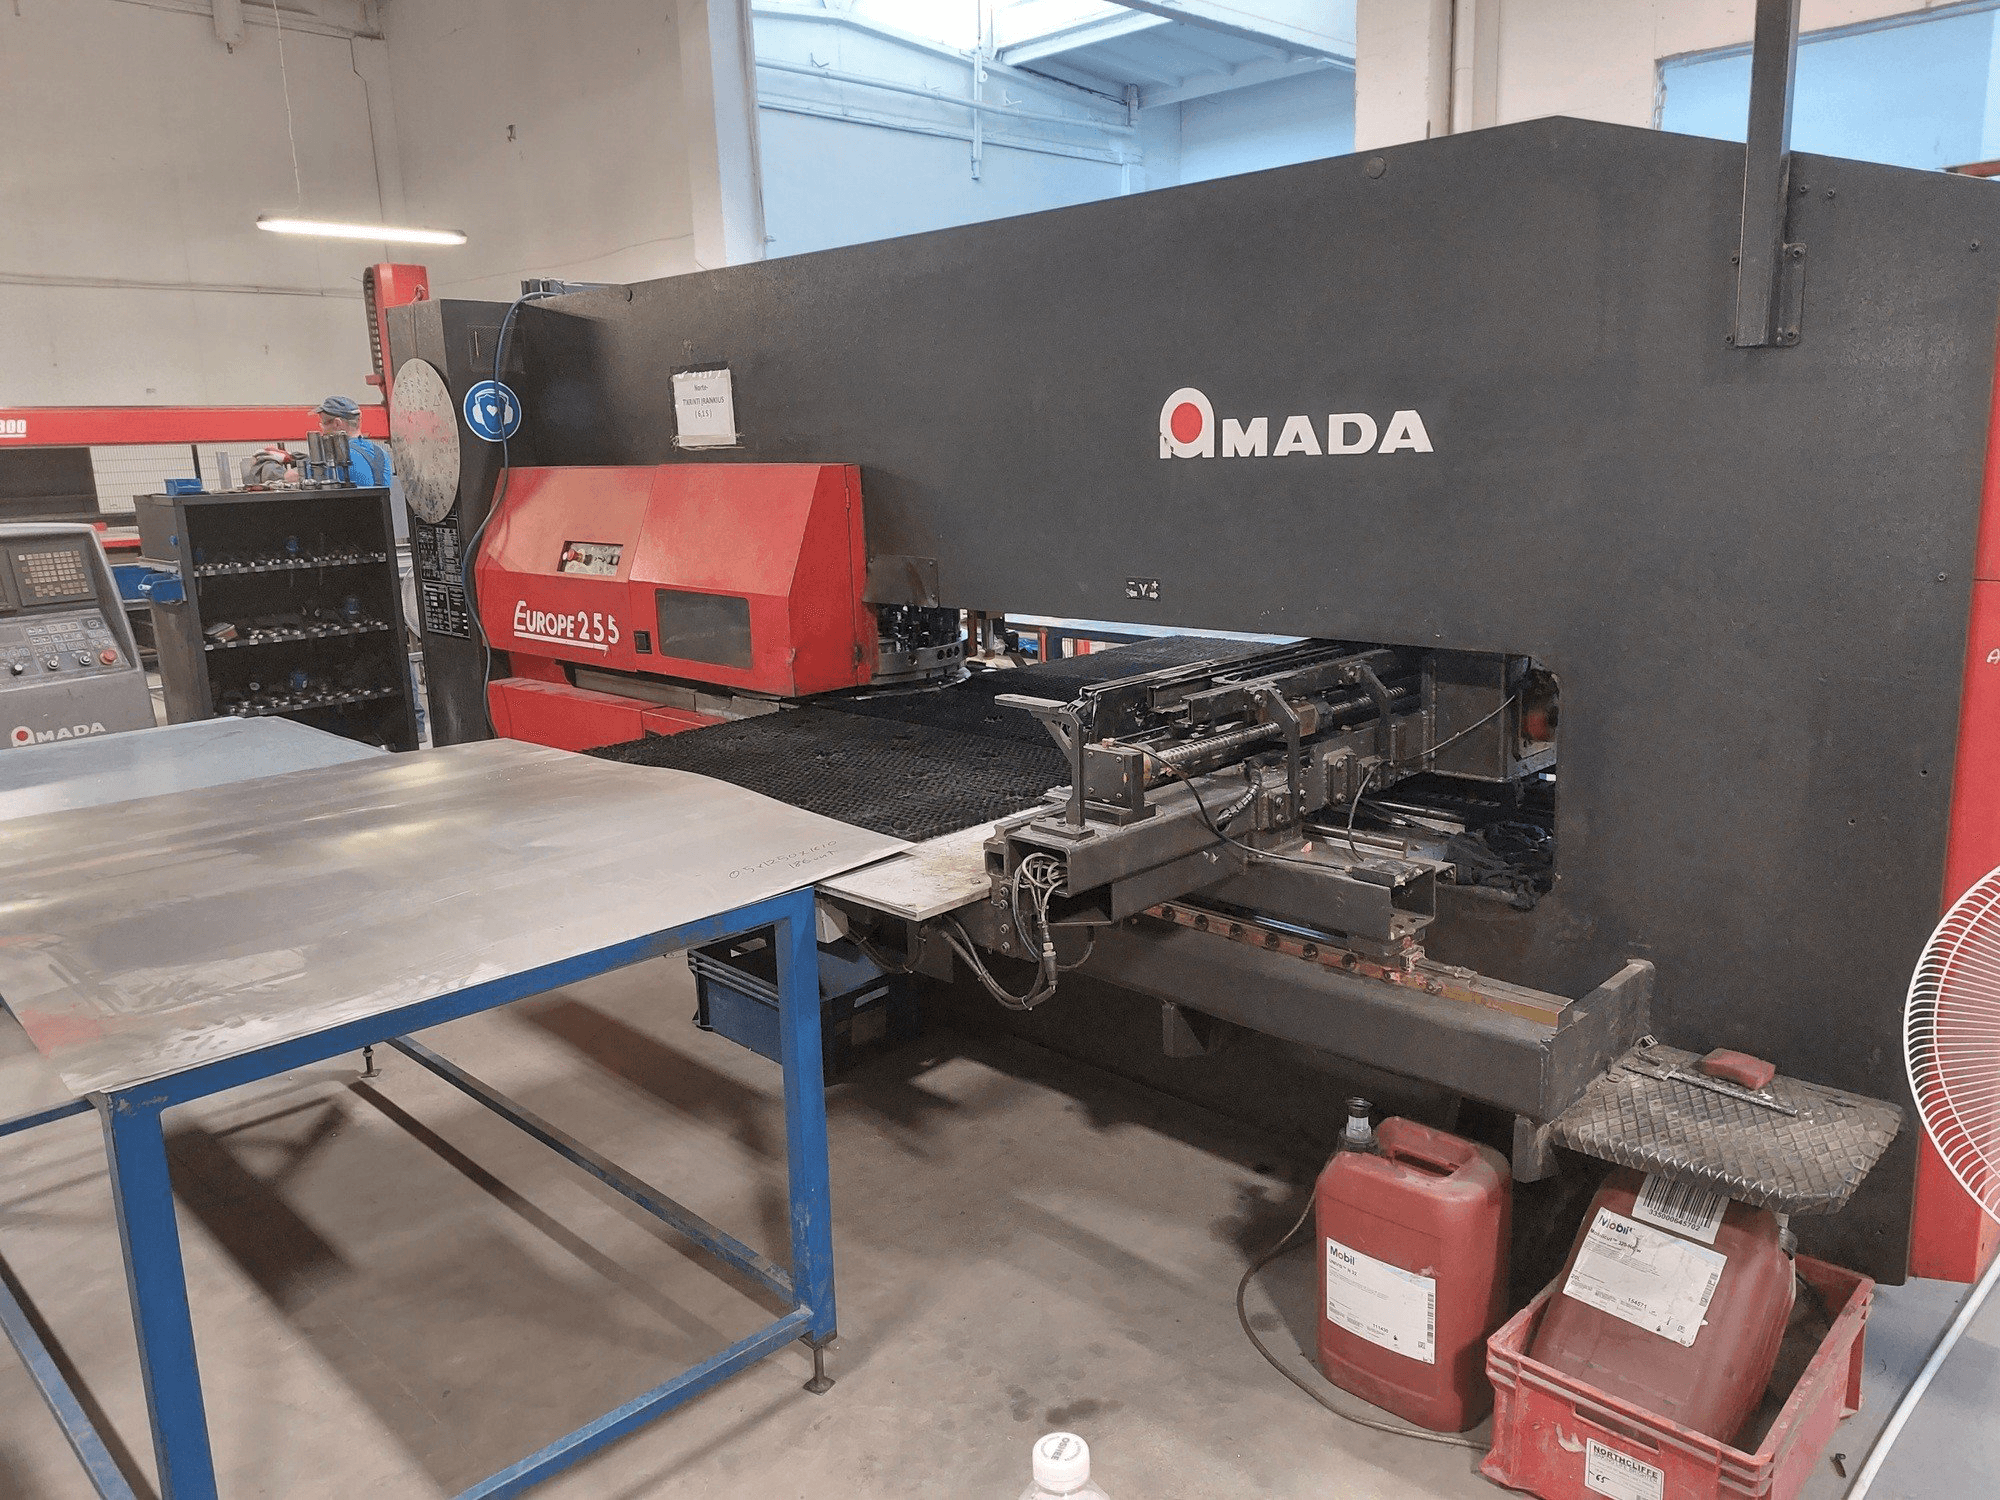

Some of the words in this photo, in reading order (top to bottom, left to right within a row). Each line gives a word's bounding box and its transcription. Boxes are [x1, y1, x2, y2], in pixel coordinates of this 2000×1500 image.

[1159, 387, 1434, 459] AMADA
[513, 600, 575, 638] EUROPE
[577, 611, 620, 645] 255
[10, 722, 106, 747] AMADA
[1330, 1245, 1355, 1266] Mobil
[1593, 1445, 1659, 1479] NORTHCLIFFE
